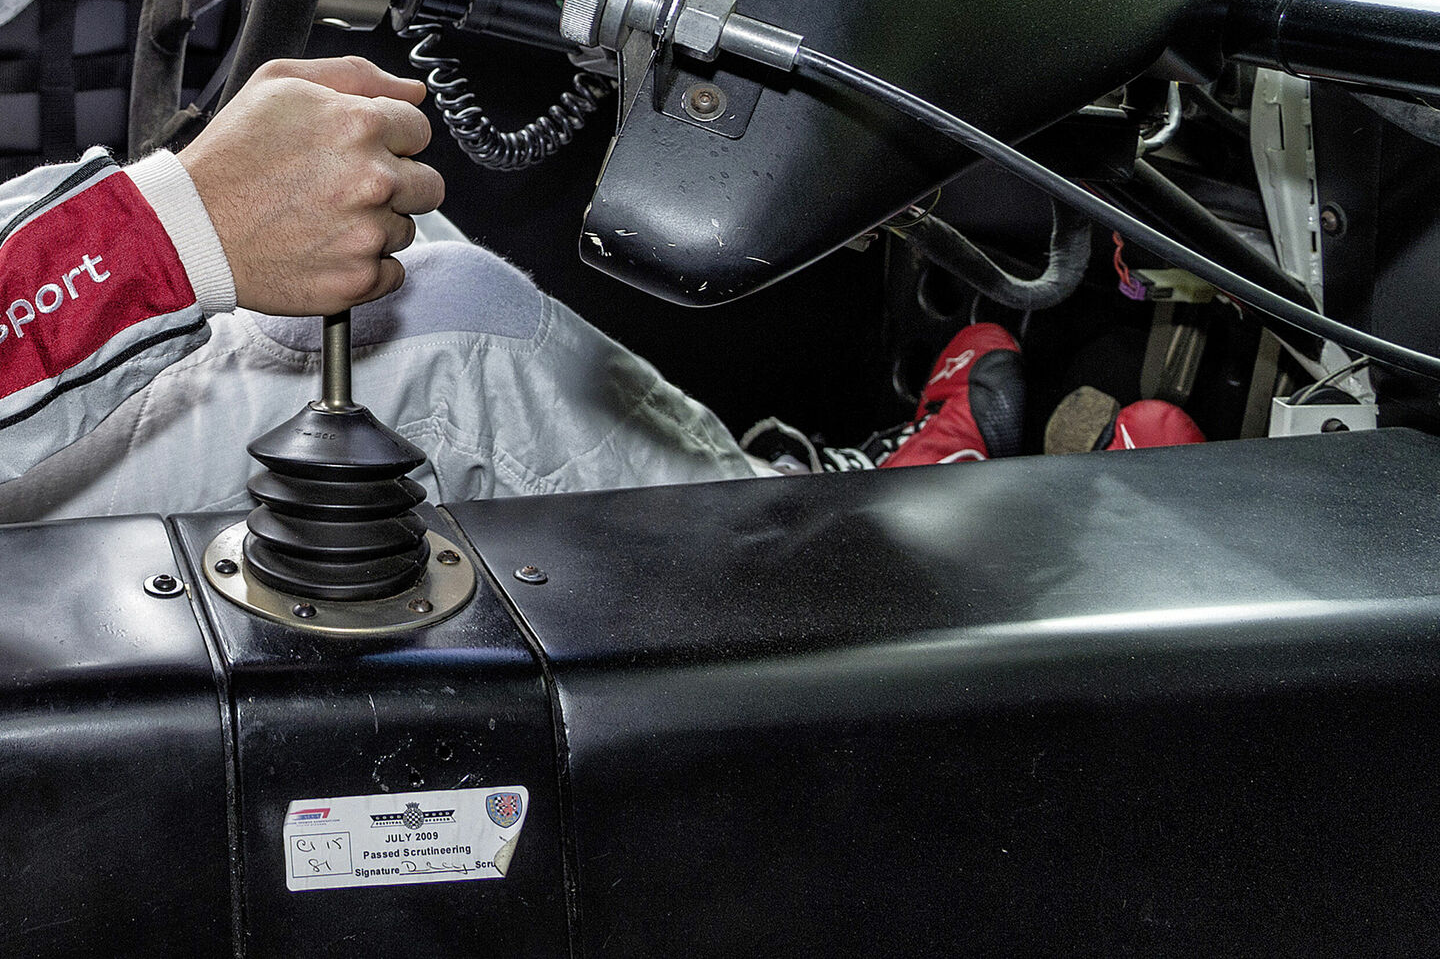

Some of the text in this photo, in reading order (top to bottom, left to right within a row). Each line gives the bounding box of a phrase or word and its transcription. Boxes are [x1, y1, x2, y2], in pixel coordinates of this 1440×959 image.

[385, 832, 439, 843] JULY 2009
[363, 845, 472, 860] Passed Scrutineering
[355, 866, 400, 878] Signature
